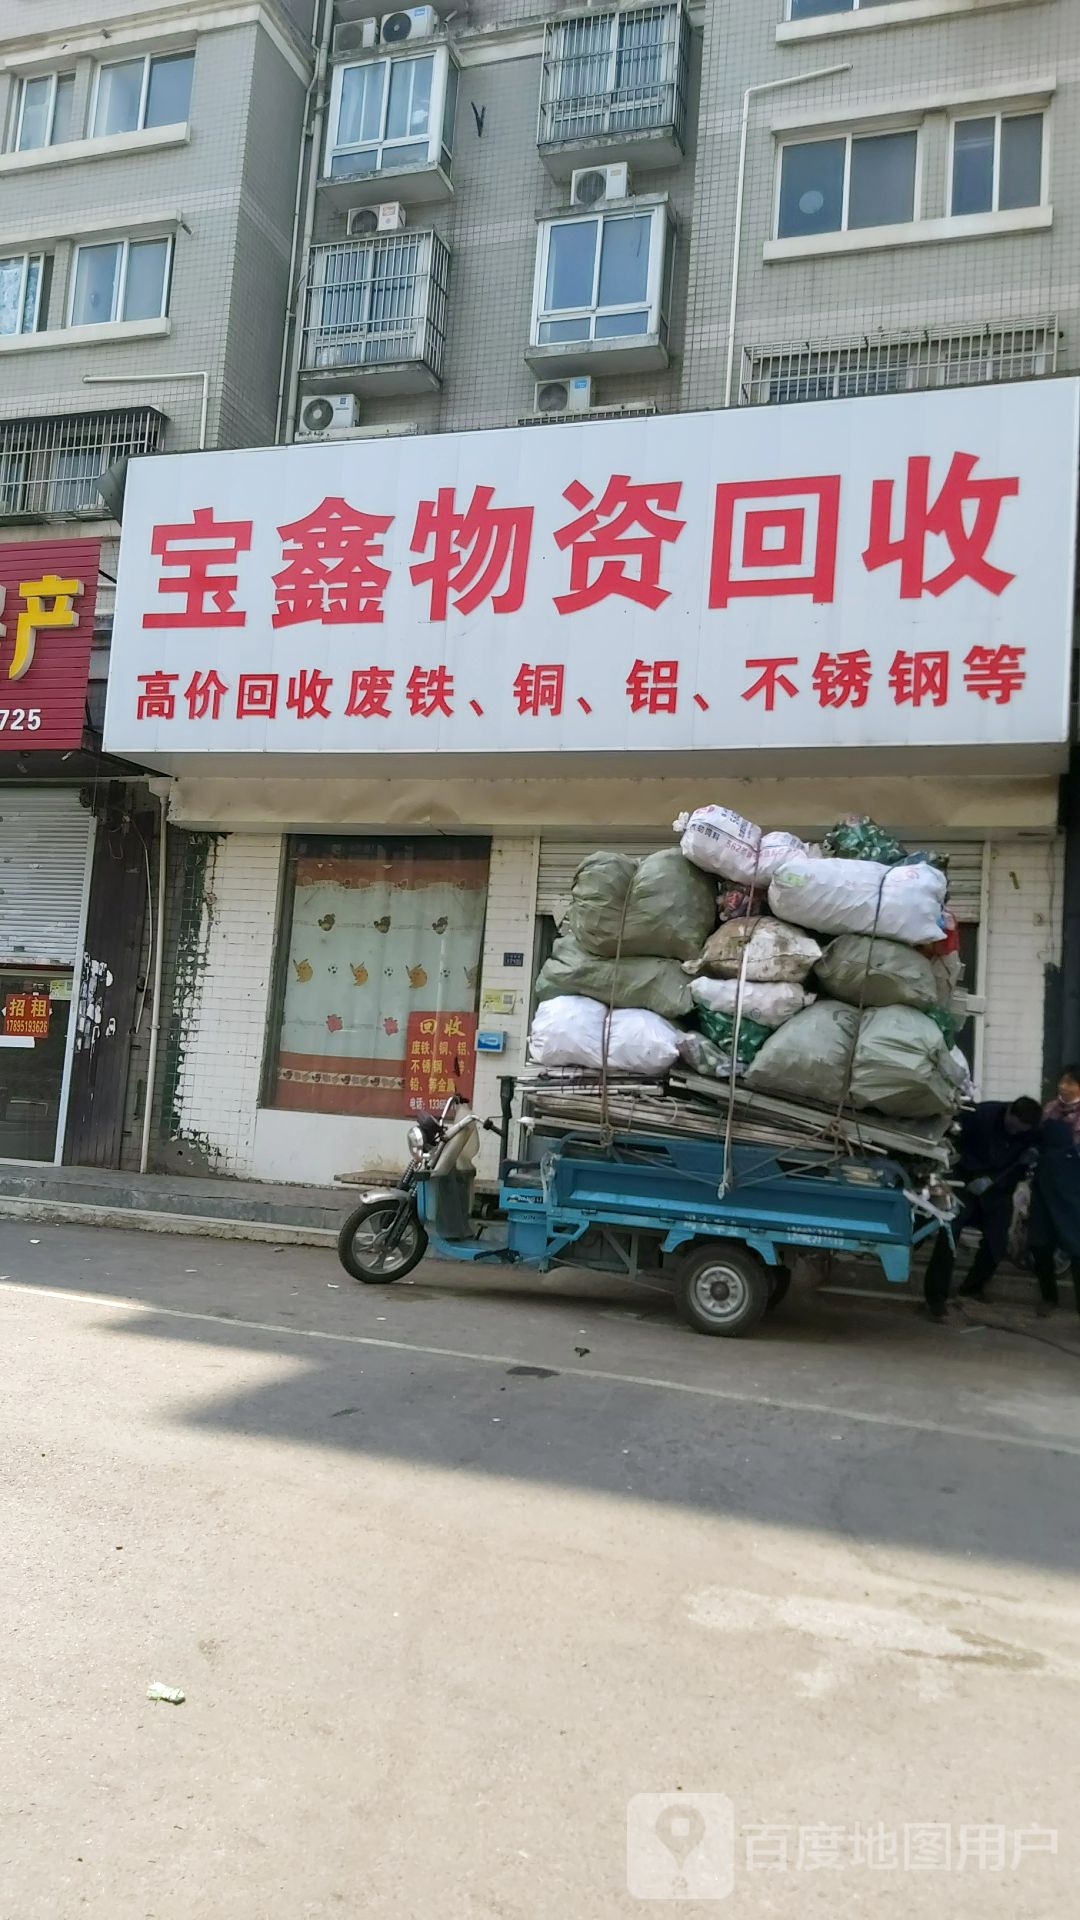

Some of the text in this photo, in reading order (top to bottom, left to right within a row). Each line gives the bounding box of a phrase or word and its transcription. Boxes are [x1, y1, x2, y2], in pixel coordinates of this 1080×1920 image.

[142, 452, 1019, 629] 宝鑫物资回收
[0, 575, 84, 680] 产
[136, 644, 1027, 721] 高价回收废铁、铜、铝、不锈钢等
[9, 997, 47, 1018] 招租
[420, 1015, 466, 1037] 回收
